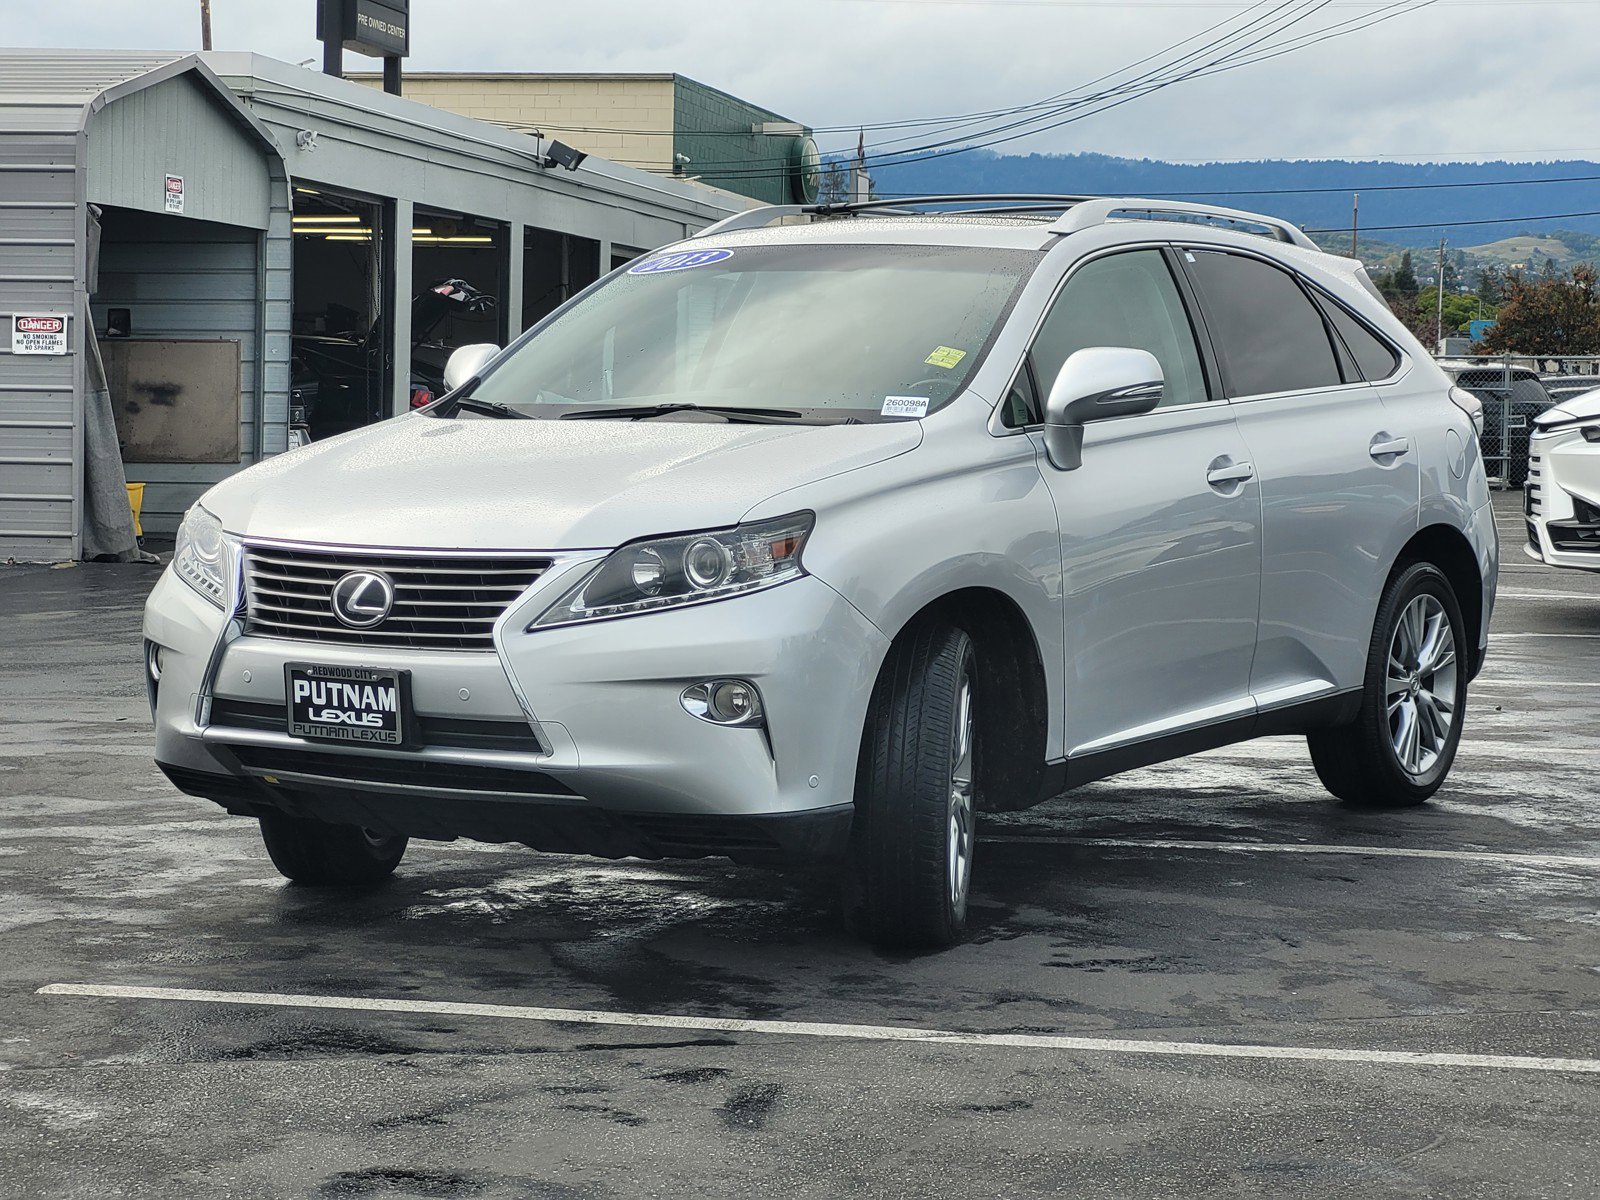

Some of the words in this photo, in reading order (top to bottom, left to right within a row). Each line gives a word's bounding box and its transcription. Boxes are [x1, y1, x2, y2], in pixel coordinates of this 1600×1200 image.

[357, 13, 368, 27] PRE
[368, 17, 387, 32] OWNED
[387, 23, 406, 39] CENTER
[640, 250, 720, 272] 2013
[21, 320, 59, 330] DANGER
[885, 399, 927, 408] 260098A
[313, 666, 352, 678] REDWOOD
[355, 669, 373, 680] CITY
[293, 679, 397, 712] PUTNAM
[308, 707, 384, 727] LEXUS
[293, 723, 350, 738] PUTNAM
[352, 730, 397, 743] LEXUS
